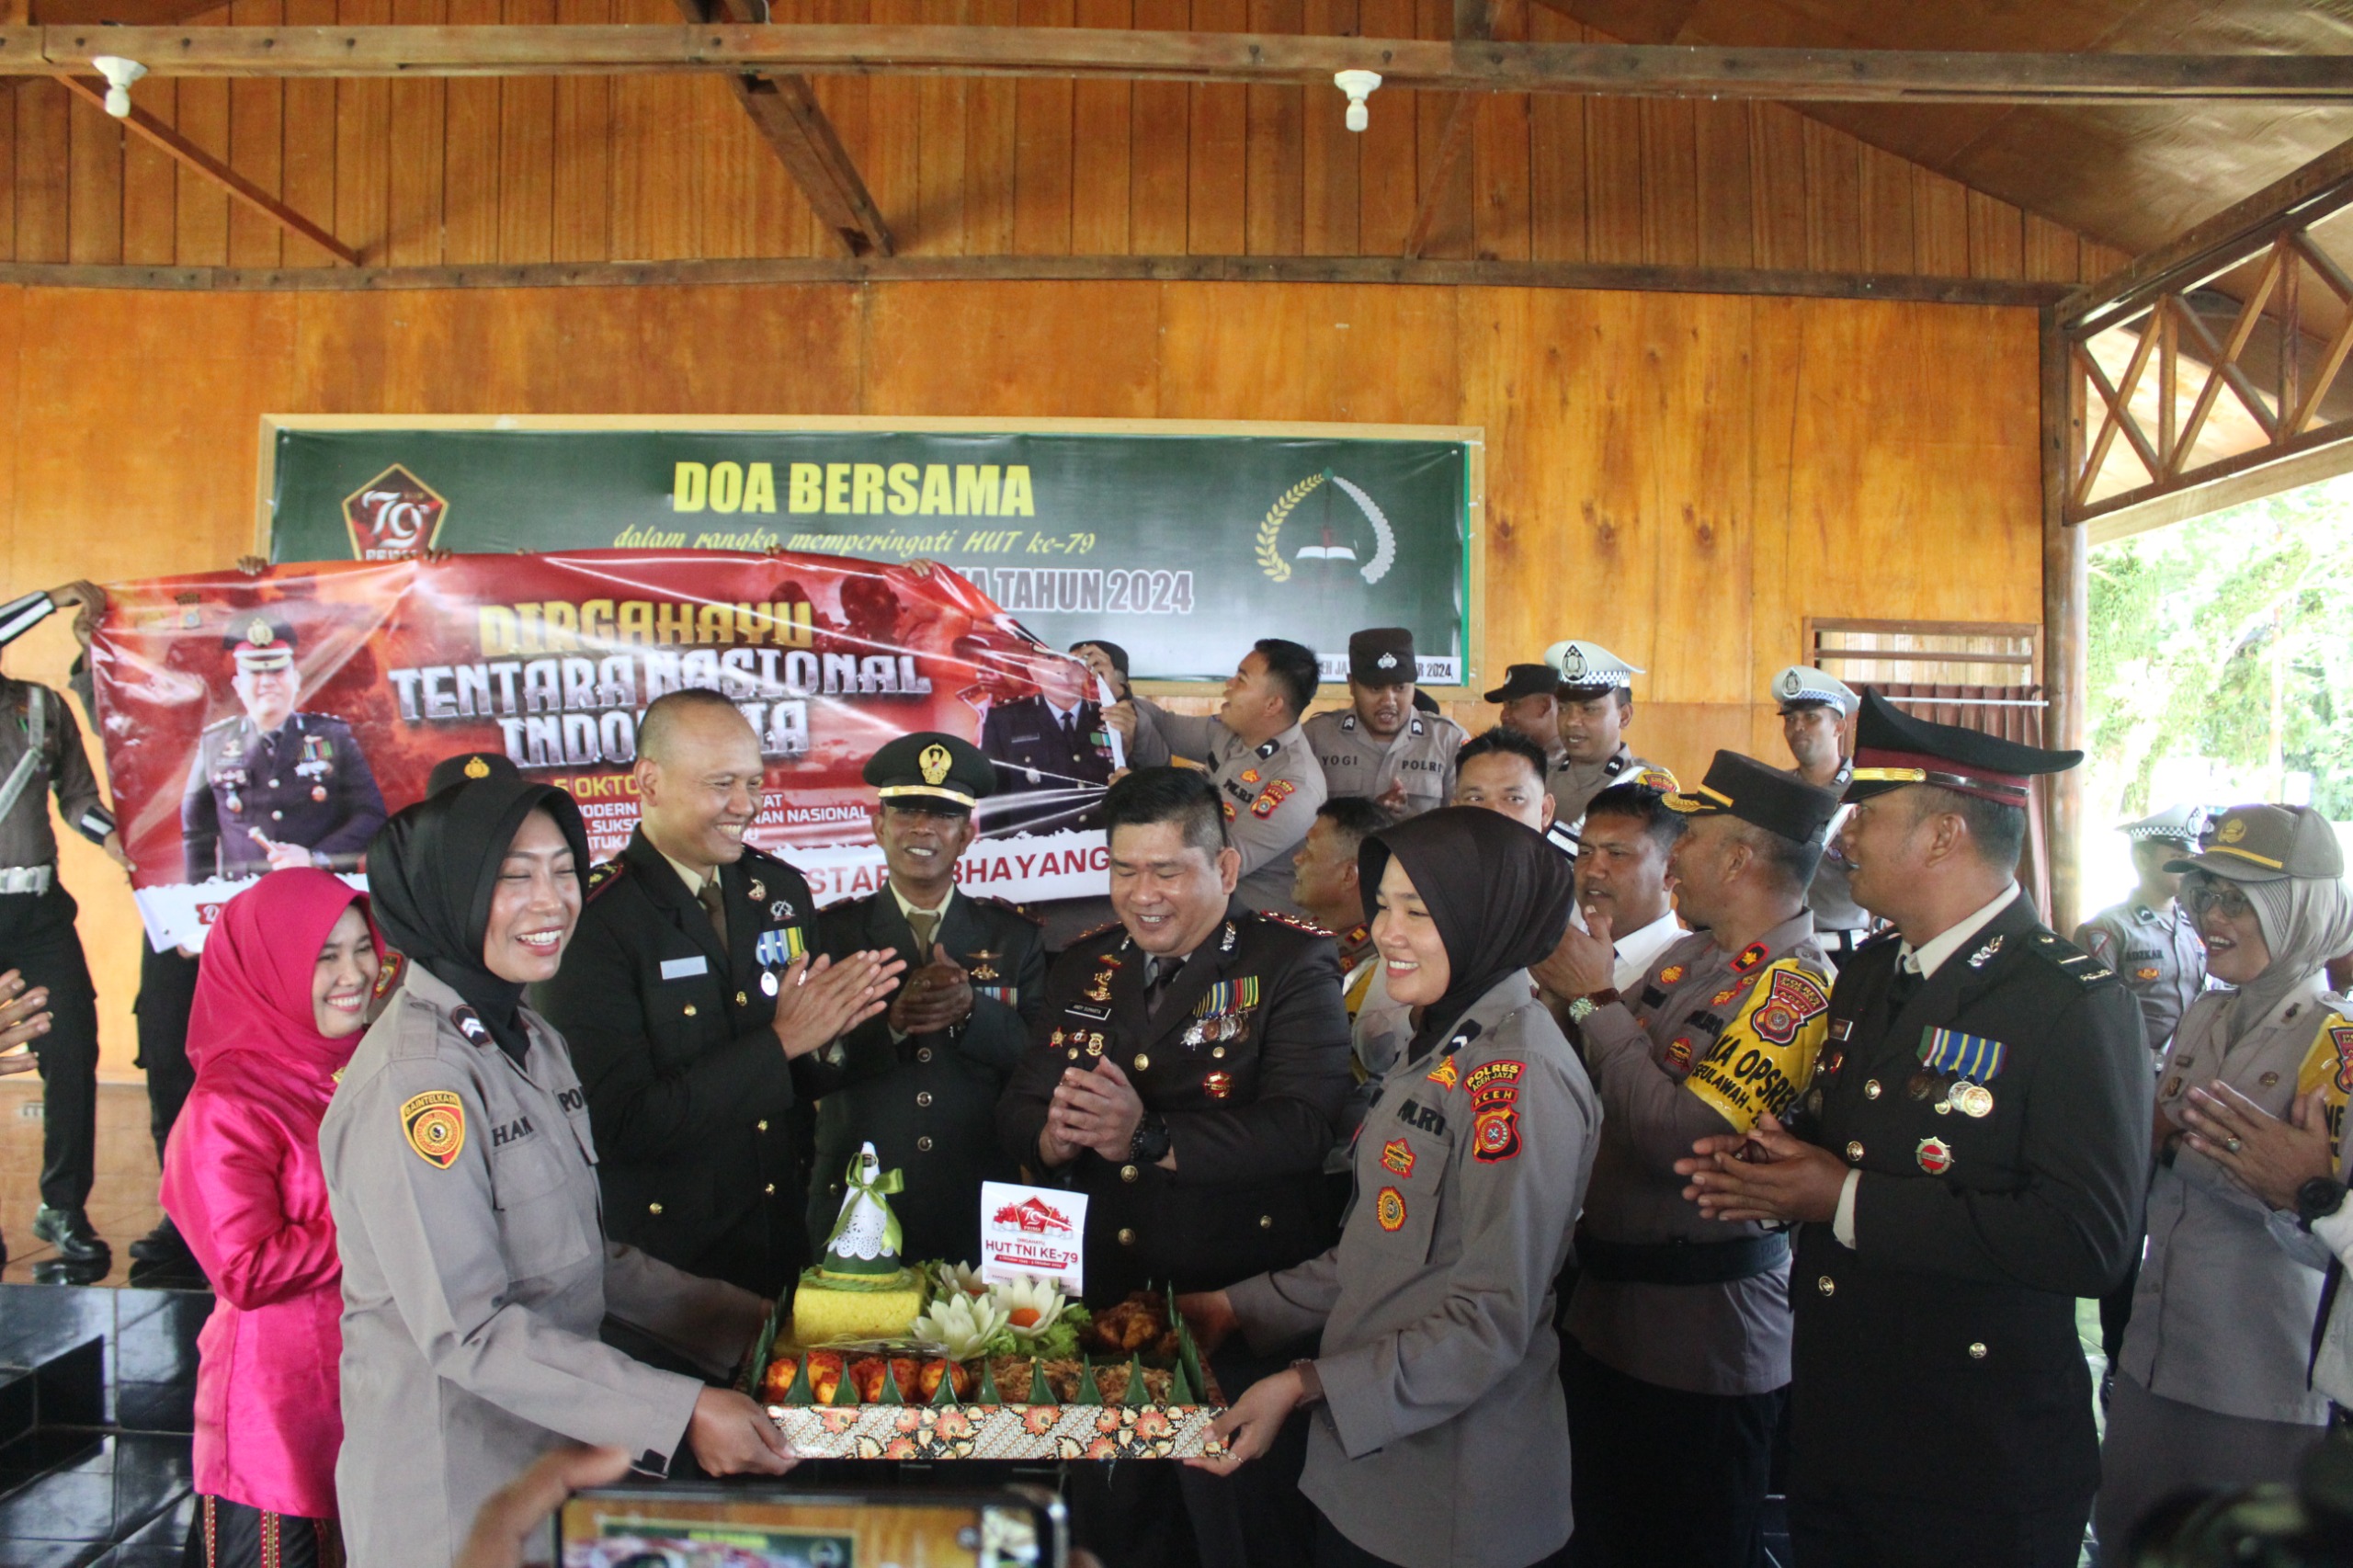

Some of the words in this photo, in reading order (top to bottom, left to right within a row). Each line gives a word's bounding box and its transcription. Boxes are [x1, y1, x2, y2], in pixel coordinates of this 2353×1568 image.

[673, 461, 777, 513] DOA
[789, 462, 1035, 517] BERSAMA
[613, 524, 687, 549] dalam
[692, 527, 779, 551] rangka
[787, 528, 959, 558] memperingati
[962, 530, 1023, 553] HUT
[1025, 530, 1097, 554] ke-79
[994, 567, 1103, 613] TAHUN
[1106, 569, 1194, 615] 2024
[479, 600, 813, 656] DIRGAHAYU
[1427, 662, 1452, 677] 2024
[387, 655, 637, 721] TENTARA
[643, 647, 933, 701] NASIONAL
[496, 699, 810, 769] INDOIA
[1321, 755, 1358, 767] YOGI
[1401, 759, 1442, 773] POLRI
[787, 804, 870, 824] NASIONAL
[1467, 1063, 1519, 1087] POLRES
[1472, 1074, 1491, 1092] ACEH
[1492, 1071, 1514, 1080] JAYA
[1474, 1090, 1512, 1107] ACEH
[985, 1239, 1012, 1254] HUT
[1015, 1244, 1037, 1257] TNI
[1040, 1246, 1079, 1265] KE-79
